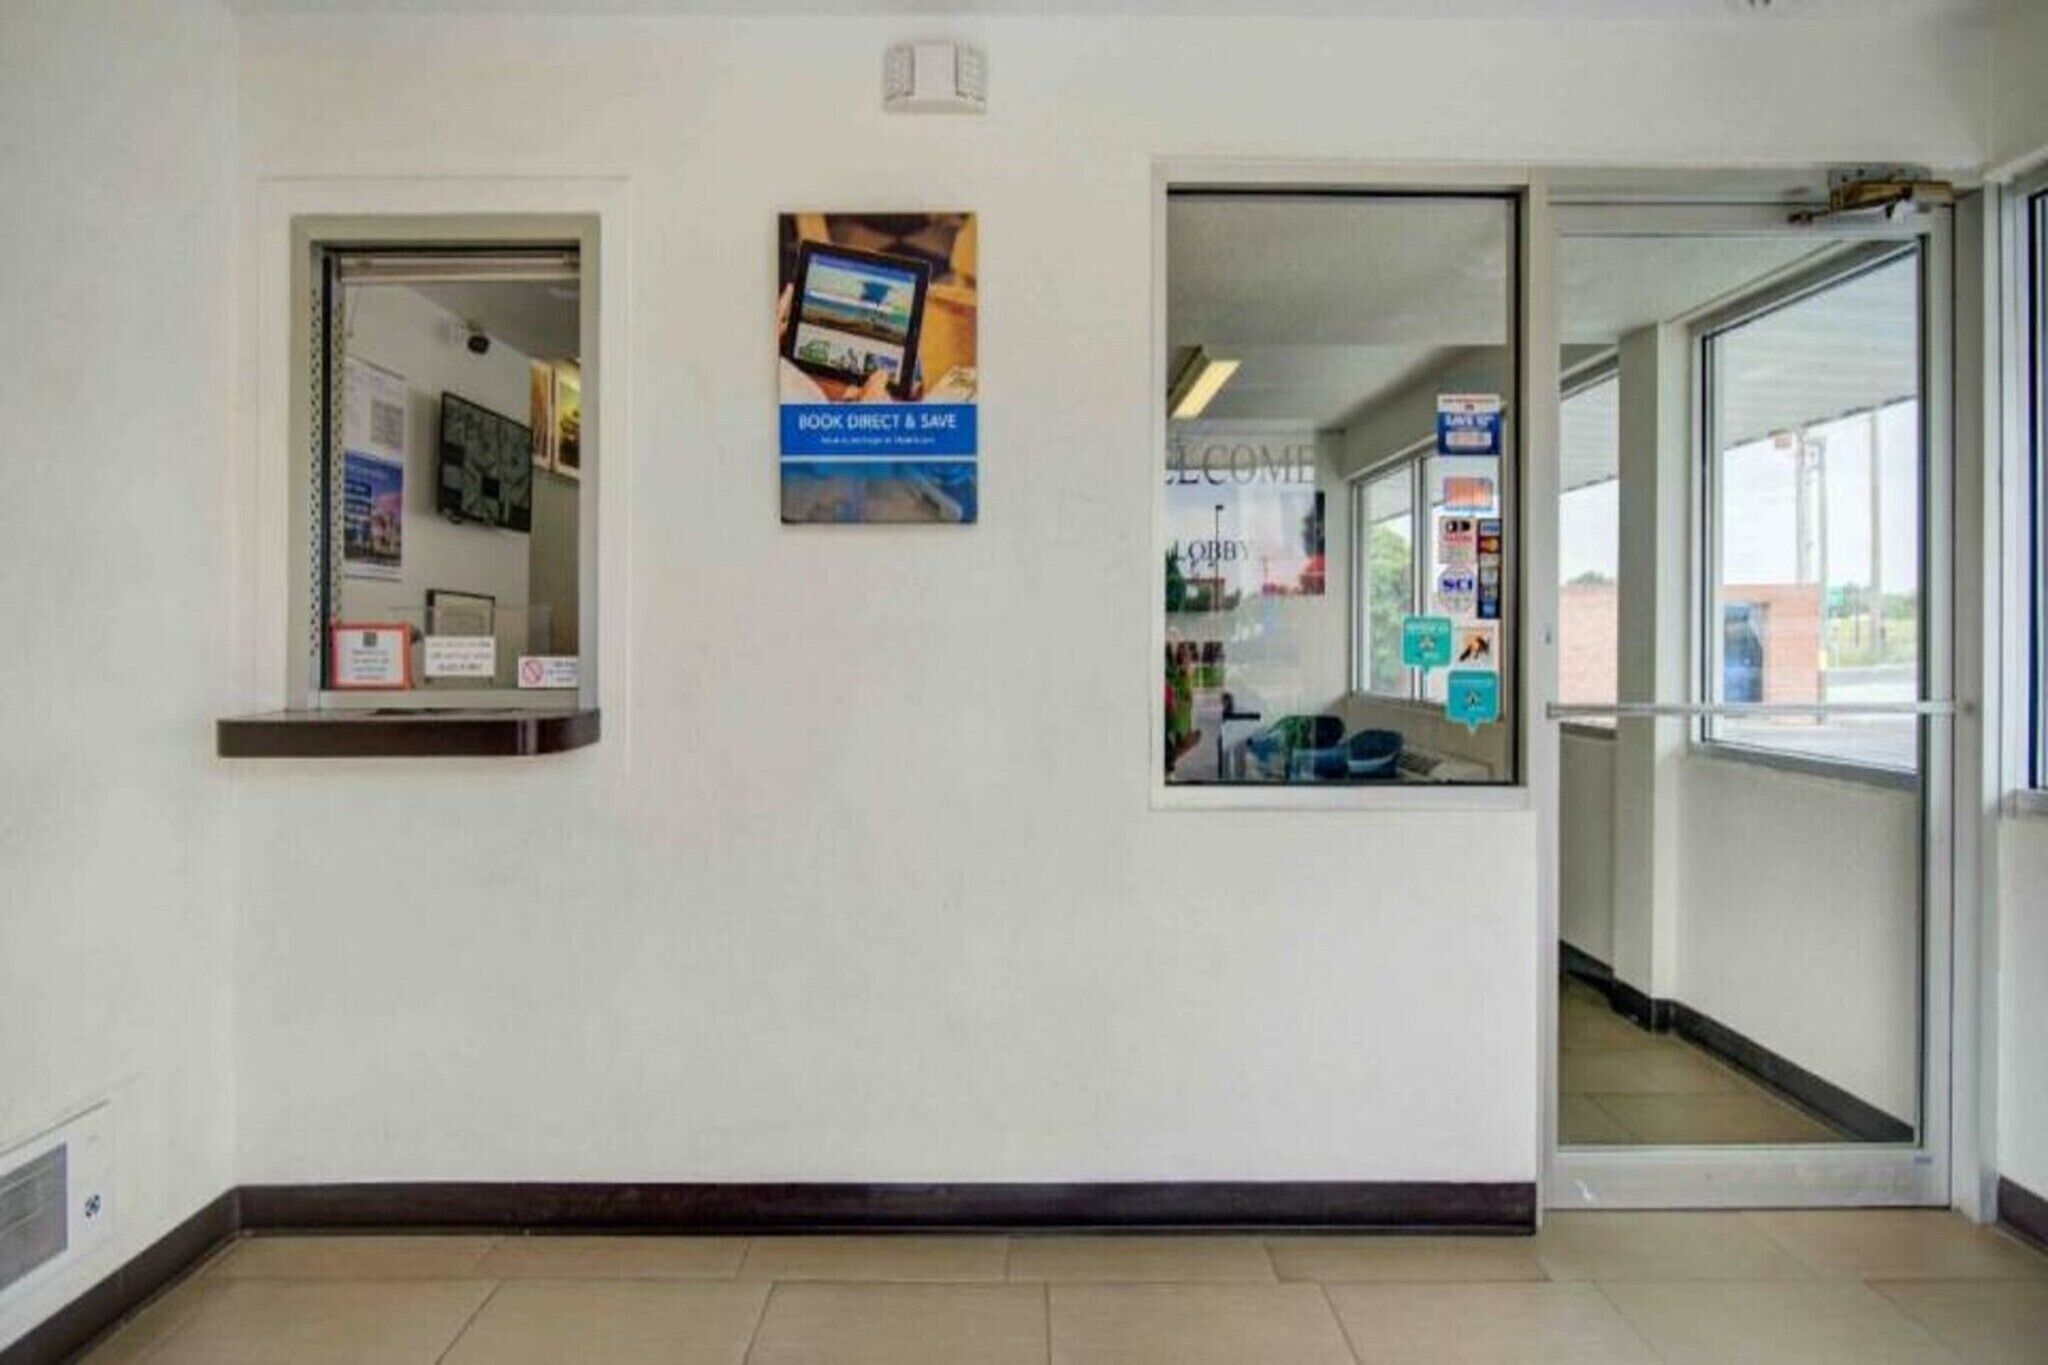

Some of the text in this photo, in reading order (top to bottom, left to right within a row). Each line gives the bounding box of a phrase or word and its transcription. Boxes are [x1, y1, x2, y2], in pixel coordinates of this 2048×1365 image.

[798, 413, 957, 430] BOOK DIRECT & SAVE
[1166, 444, 1315, 486] LCOME
